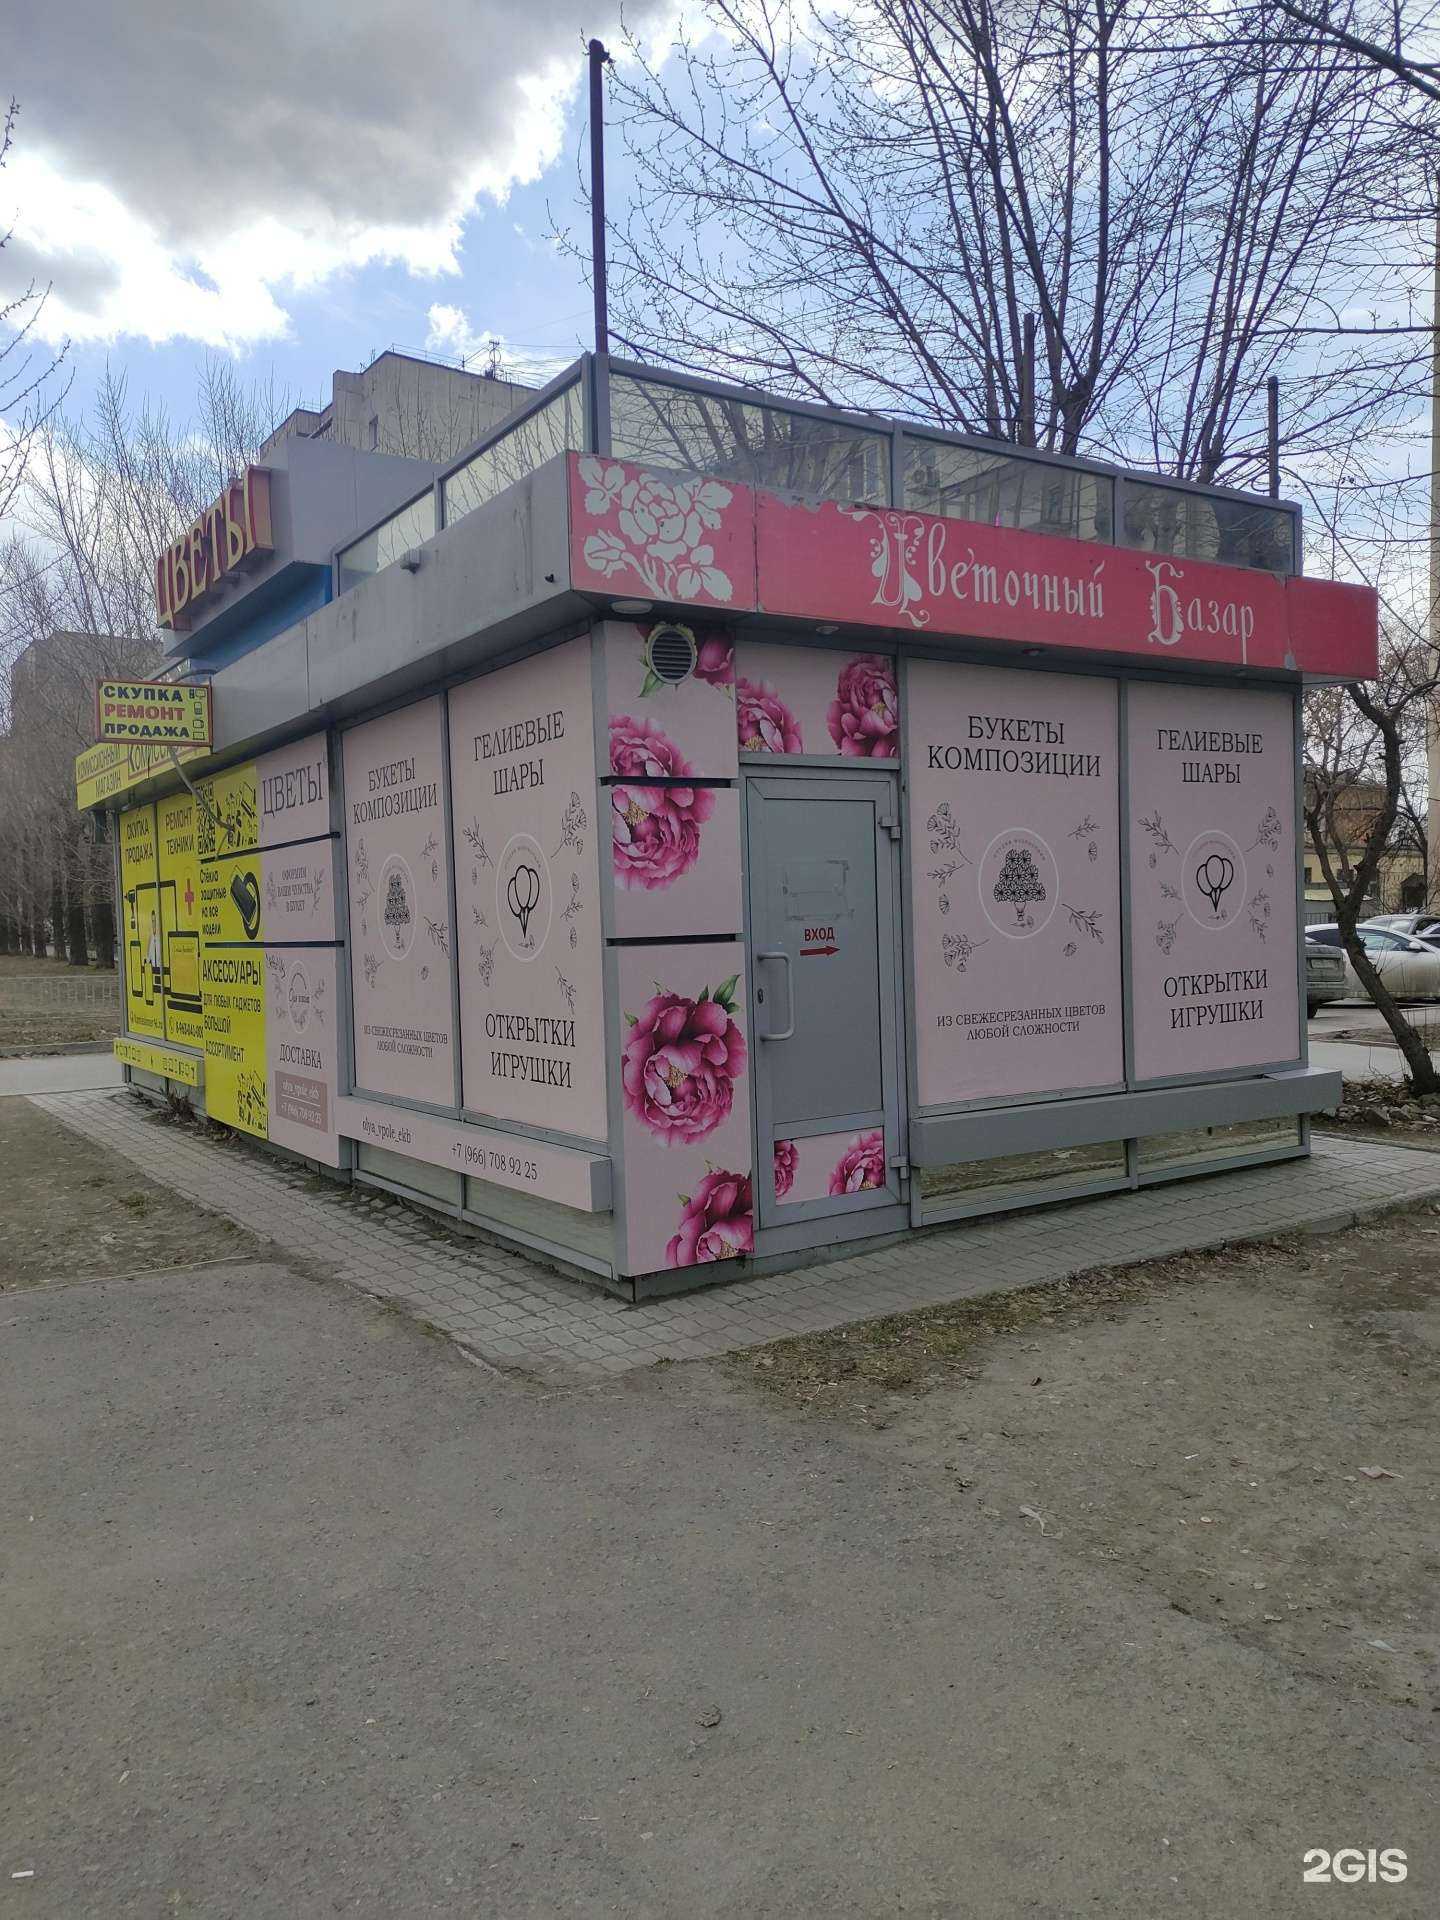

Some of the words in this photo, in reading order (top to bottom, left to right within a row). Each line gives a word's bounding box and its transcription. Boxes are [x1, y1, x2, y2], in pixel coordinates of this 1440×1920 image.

[155, 466, 264, 630] ЦВЕТЫ
[853, 512, 1105, 627] Цветочный
[1145, 560, 1254, 665] Базар
[103, 685, 183, 703] СКУПКА
[104, 703, 186, 721] РЕМОНТ
[104, 722, 190, 738] ПРОДАЖА
[473, 710, 565, 761] ГЕЛИЕВЫЕ
[968, 715, 1064, 744] БУКЕТЫ
[1157, 729, 1263, 753] ГЕЛИЕВЫЕ
[368, 757, 415, 792] БУКЕТЫ
[928, 745, 1100, 778] КОМПОЗИЦИИ
[1181, 762, 1240, 783] ШАРЫ
[262, 763, 323, 816] ЦВЕТЫ
[493, 759, 544, 795] ШАРЫ
[353, 783, 437, 825] КОМПОЗИЦИИ
[165, 807, 192, 831] РЕМОНТ
[125, 842, 154, 865] ПРОДАЖА
[166, 834, 194, 856] ТЕХНИКИ
[804, 926, 836, 942] ВХОД
[202, 959, 261, 986] АКСЕССУАРЫ
[1164, 969, 1268, 997] ОТКРЫТКИ
[204, 1015, 231, 1034] БОЛЬШОЙ
[936, 1015, 953, 1027] ИЗ
[955, 1007, 1062, 1025] СВЕЖЕСРЕЗАННЫХ
[1064, 1004, 1106, 1018] ЦВЕТОВ
[1170, 1000, 1264, 1028] ИГРУШКИ
[485, 1013, 575, 1047] ОТКРЫТКИ
[967, 1024, 1009, 1040] ЛЮБОЙ
[1012, 1021, 1080, 1037] СЛОЖНОСТИ
[279, 1043, 322, 1070] ДОСТАВКА
[491, 1052, 572, 1088] ИГРУШКИ
[362, 1117, 412, 1143] olya_vpole_ekb
[451, 1143, 462, 1155] +7
[464, 1145, 486, 1169] (966)
[489, 1152, 506, 1172] 708
[509, 1157, 521, 1176] 92
[524, 1162, 538, 1180] 25
